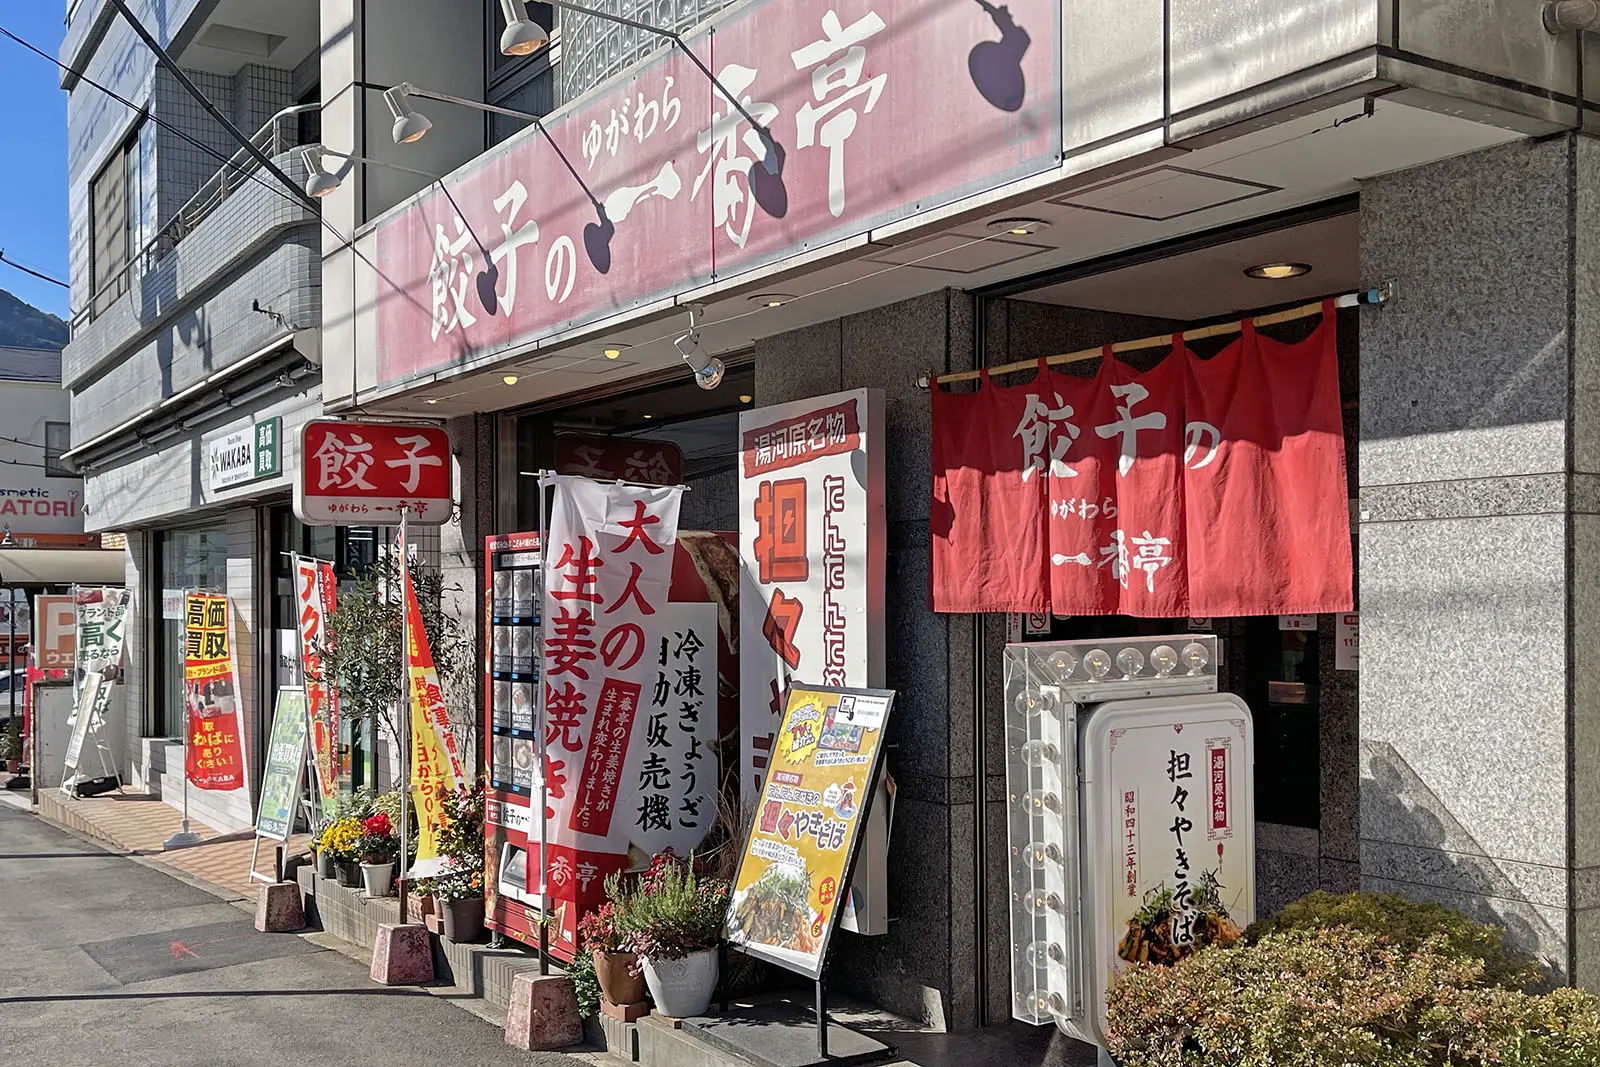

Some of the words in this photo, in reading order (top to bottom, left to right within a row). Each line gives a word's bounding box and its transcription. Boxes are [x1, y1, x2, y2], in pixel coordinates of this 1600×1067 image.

[582, 76, 682, 171] ゆがわら
[219, 443, 252, 472] WAKABA
[312, 431, 444, 493] 餃子
[754, 411, 846, 467] 湯河原名物
[1013, 383, 1220, 482] 餃子の
[327, 503, 369, 513] ゆがわら
[187, 599, 227, 628] 高価
[600, 500, 665, 670] 大人の
[78, 619, 122, 648] 高く
[187, 631, 227, 659] 買取
[576, 687, 618, 829] 生まれ変わりました。
[595, 690, 637, 813] 一番亭の生姜焼きが
[674, 628, 705, 829] 冷凍ぎょうざ
[1213, 755, 1225, 823] 湯河原名物
[760, 800, 846, 849] 担々やきそば
[1124, 790, 1137, 898] 昭和四十三年創業
[1167, 750, 1197, 945] 担々やきそば
